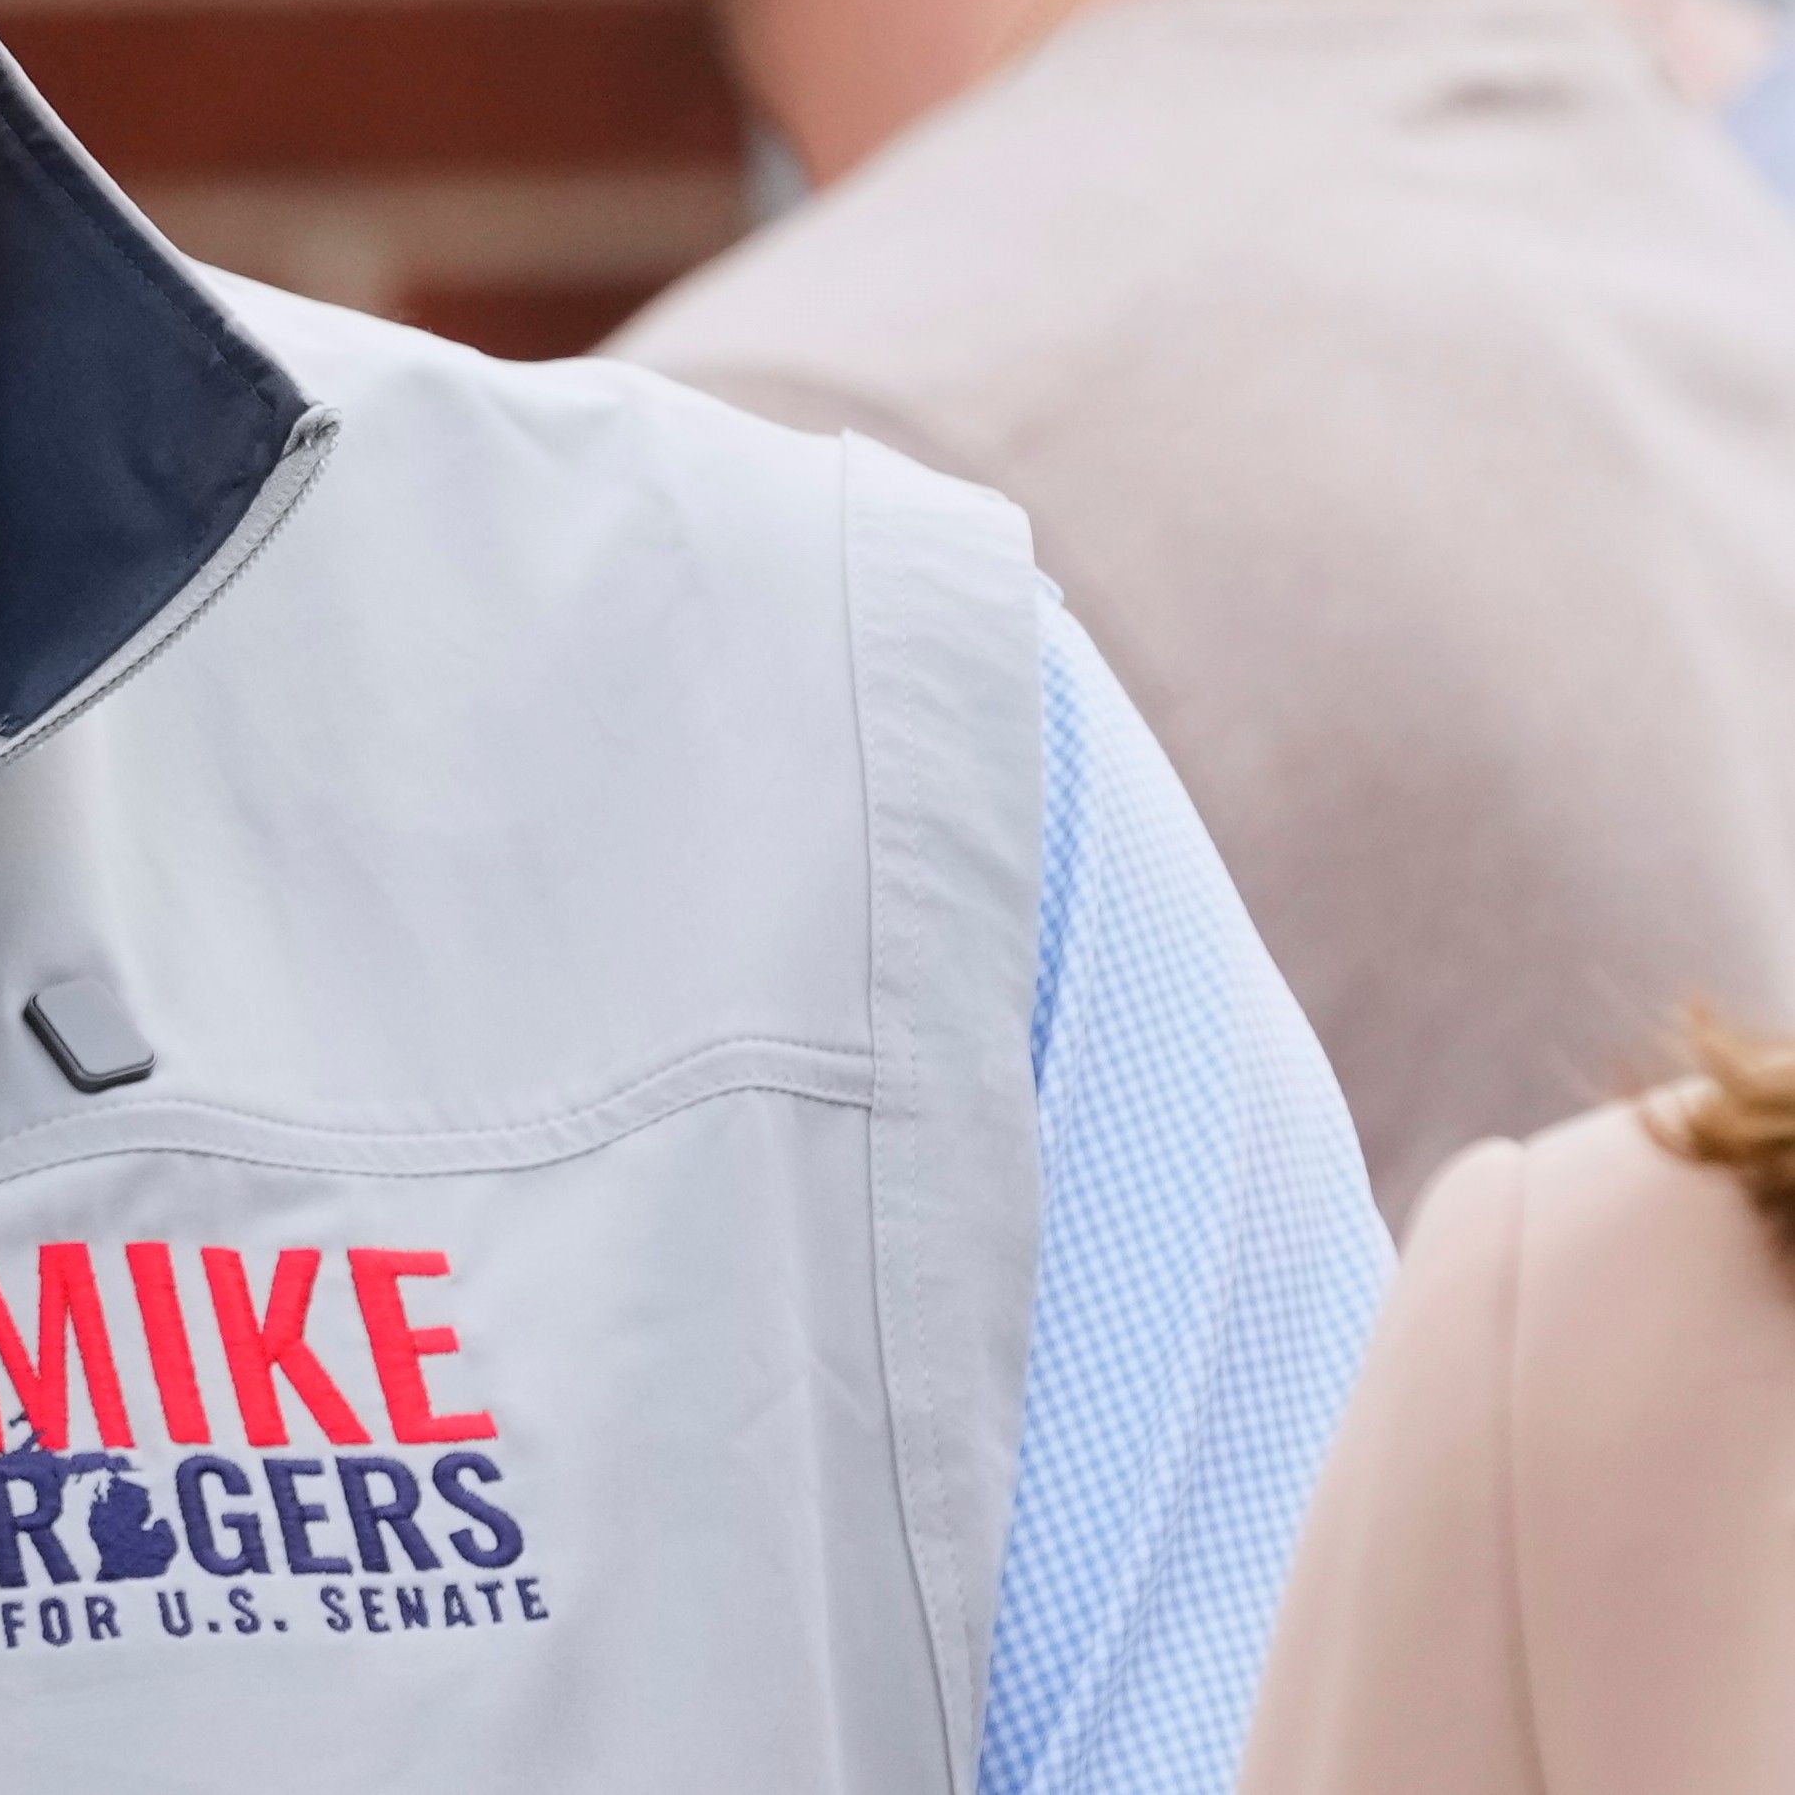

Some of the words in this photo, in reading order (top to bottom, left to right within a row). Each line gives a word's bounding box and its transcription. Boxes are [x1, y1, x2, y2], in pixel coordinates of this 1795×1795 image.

[1, 1591, 122, 1649] FOR
[158, 1587, 290, 1638] U.S.
[326, 1577, 550, 1635] SENATE
